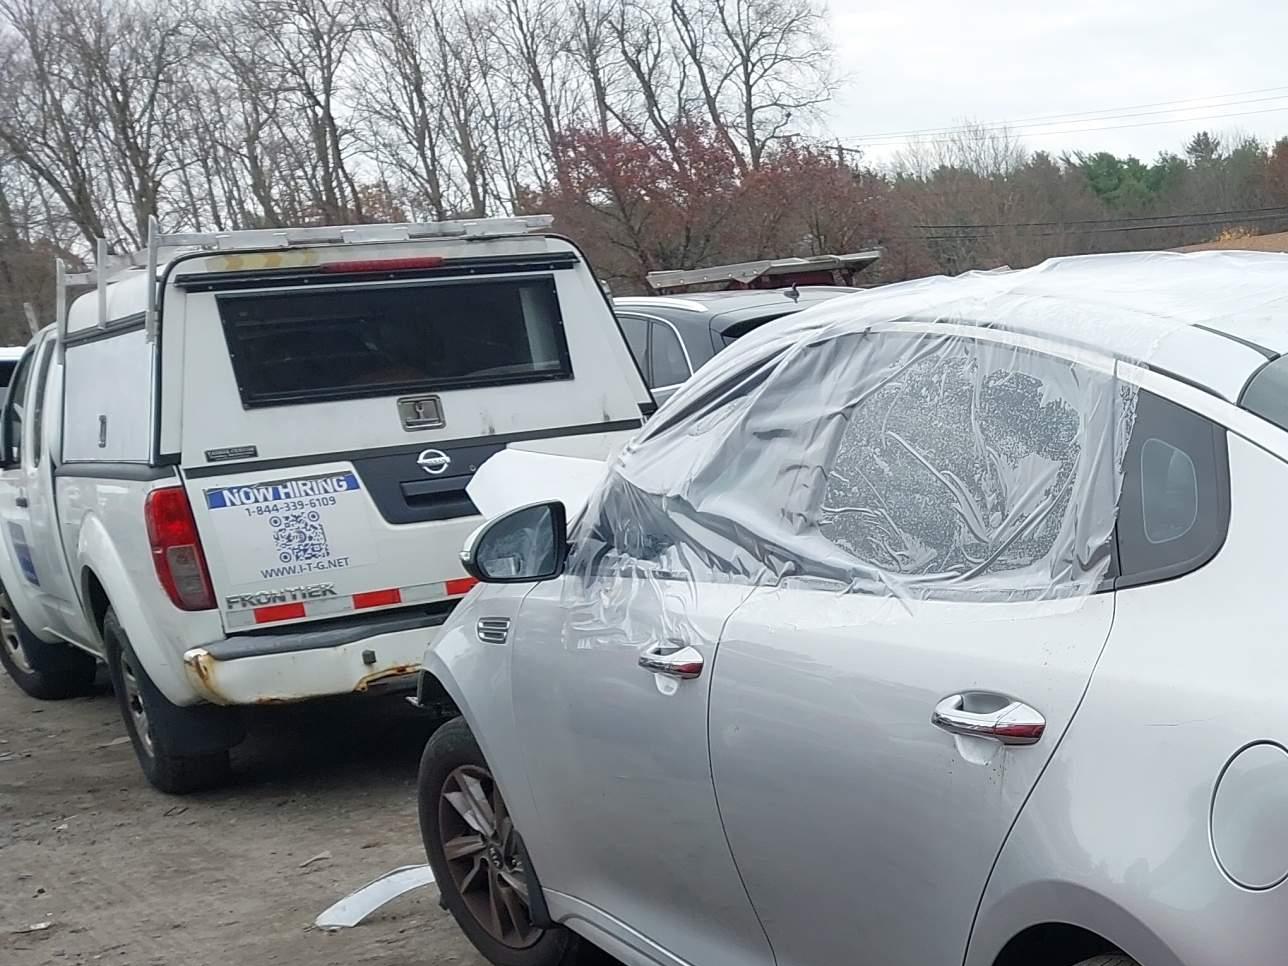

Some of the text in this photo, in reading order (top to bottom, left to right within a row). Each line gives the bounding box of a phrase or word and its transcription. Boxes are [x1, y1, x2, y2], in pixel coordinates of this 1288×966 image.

[222, 476, 348, 507] NOW HIRING
[245, 496, 337, 517] 1-844-339-6109
[260, 557, 350, 579] WWW.I-T-G.NET
[225, 583, 337, 609] FRONTIER
